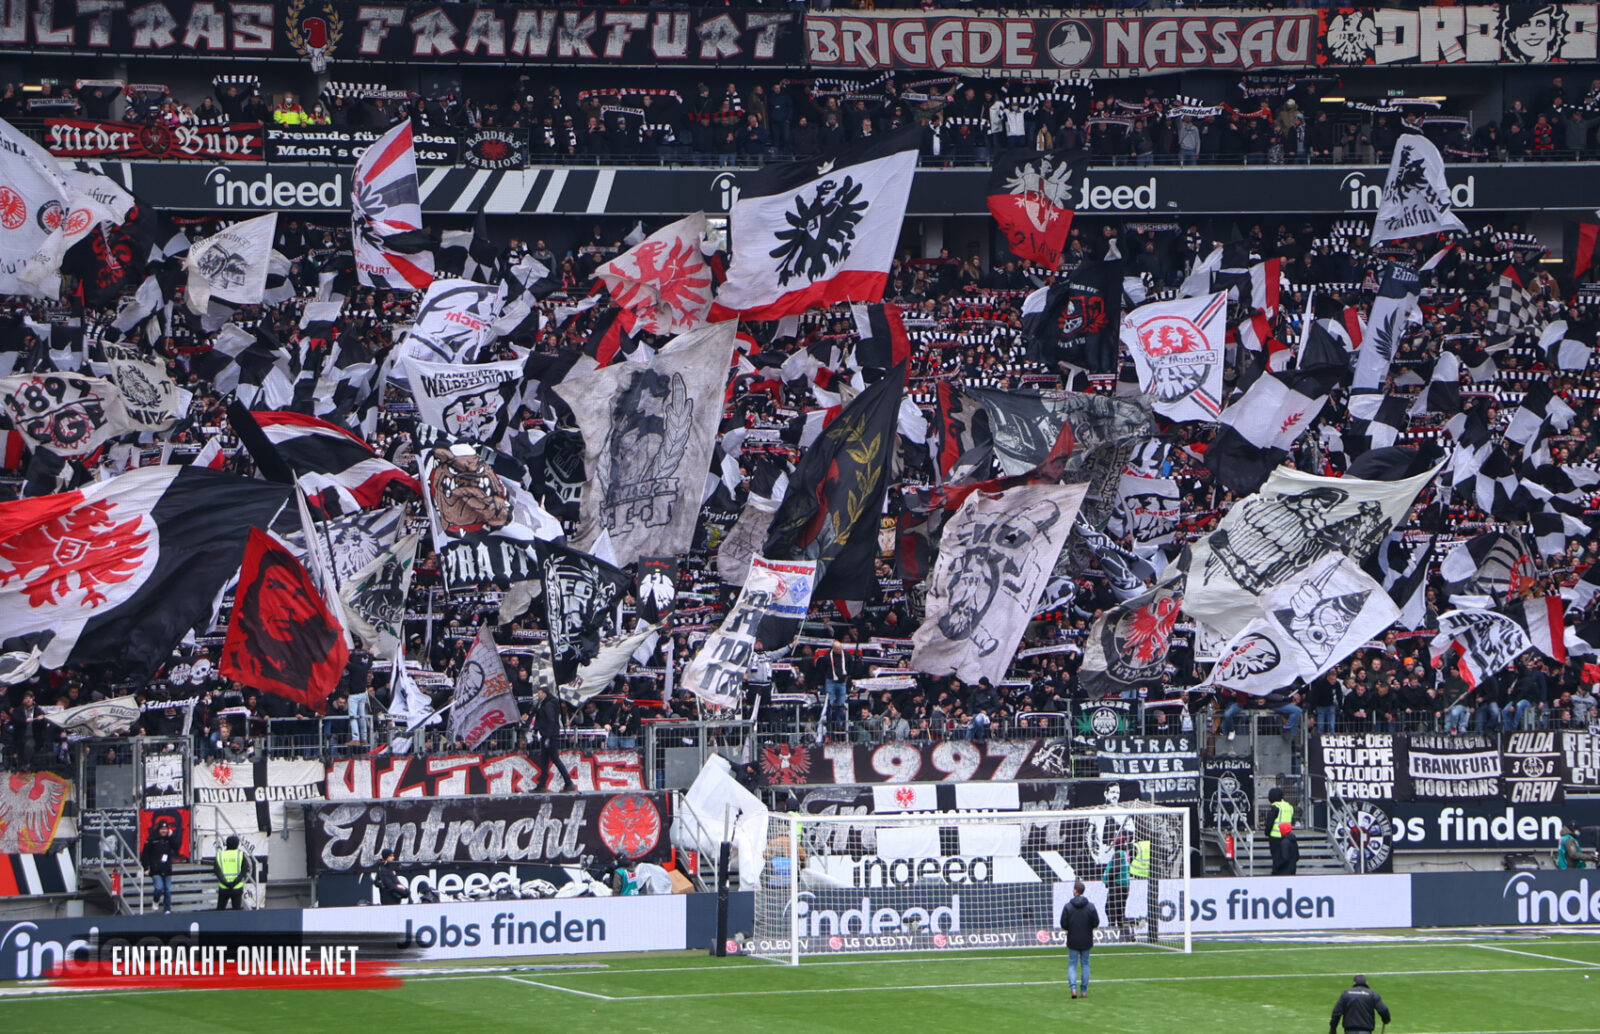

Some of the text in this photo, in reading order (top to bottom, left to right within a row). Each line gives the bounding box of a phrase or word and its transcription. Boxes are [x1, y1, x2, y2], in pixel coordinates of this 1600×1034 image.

[0, 0, 794, 60] ULTRAS FRANKFURT
[805, 17, 1313, 70] BRIGADE NASSAU
[982, 68, 1141, 79] HOOLIGANS
[50, 123, 135, 151] Nieder
[268, 130, 350, 141] Freunde
[214, 173, 342, 207] indeed
[421, 370, 515, 398] WALDSTADION
[146, 696, 200, 710] Eintracht
[1105, 738, 1189, 753] ULTRAS
[1321, 734, 1393, 748] EHRE DER
[1508, 732, 1554, 753] FULDA
[823, 740, 1038, 784] 1997
[1112, 759, 1184, 773] NEVER
[1323, 748, 1394, 766] GRUPPE
[1414, 756, 1498, 775] FRANKFURT
[1512, 761, 1554, 774] 3 6
[326, 750, 645, 800] ULTRAS
[1325, 766, 1394, 782] STADION
[199, 782, 321, 803] NUOVA GUARDIA
[1325, 781, 1395, 799] VERBOT
[1415, 778, 1500, 797] HOOLIGANS
[1511, 781, 1558, 803] CREW
[1437, 806, 1563, 842] finden
[319, 801, 587, 869] Eintracht
[798, 893, 961, 937] indeed
[1158, 887, 1335, 922] obs finden
[404, 910, 606, 950] Jobs finden
[949, 933, 1016, 945] LG OLED TV
[844, 935, 913, 947] LG OLED TV
